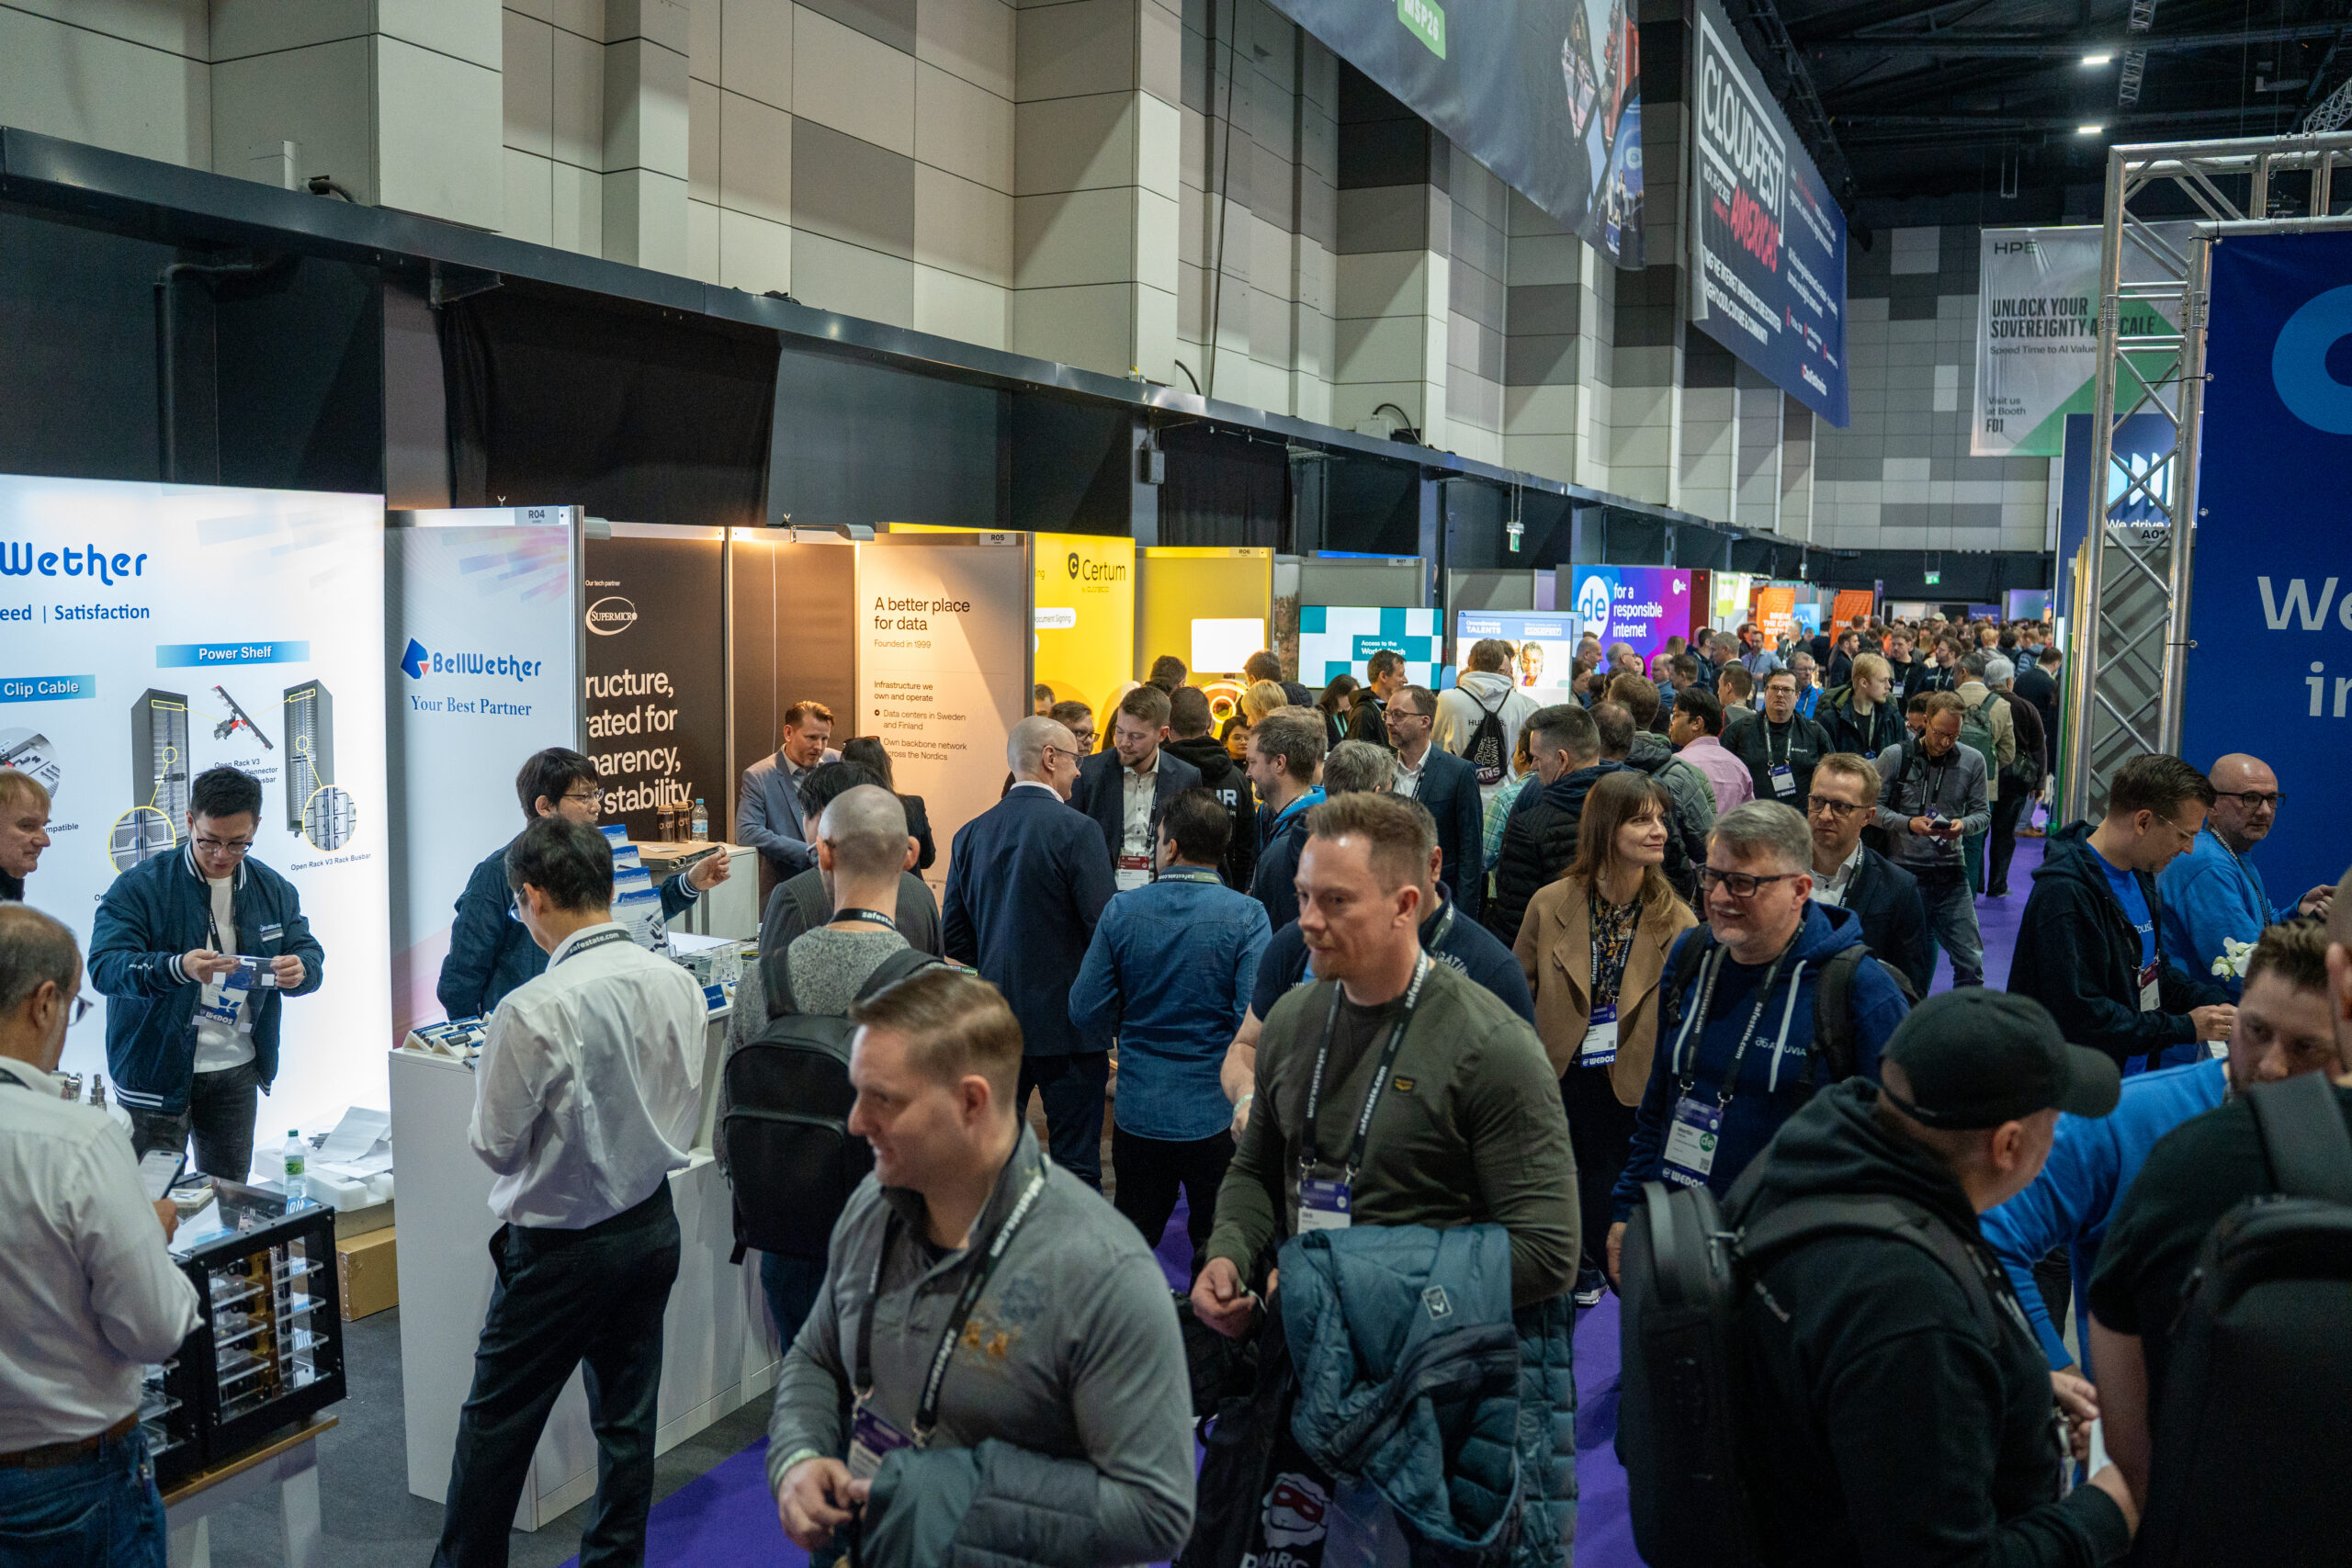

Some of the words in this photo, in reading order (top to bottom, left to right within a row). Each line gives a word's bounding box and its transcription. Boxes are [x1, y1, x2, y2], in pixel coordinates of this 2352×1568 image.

[1702, 54, 1782, 217] CLOUDFEST
[1730, 185, 1779, 273] AMERICAS
[1995, 242, 2039, 255] HPE
[1992, 298, 2047, 318] UNLOCK
[2051, 297, 2088, 316] YOUR
[1991, 318, 2087, 339] SOVEREIGNTY
[2120, 316, 2155, 335] CALE
[1990, 345, 2019, 356] Speed
[2022, 345, 2046, 355] Time
[2047, 345, 2057, 354] to
[2058, 345, 2069, 354] AI
[1988, 396, 2008, 406] Visit
[1999, 406, 2026, 416] Booth
[1986, 419, 2004, 433] F01
[528, 509, 545, 519] R04
[1082, 559, 1126, 581] Certum
[1613, 582, 1627, 600] for
[1628, 589, 1634, 599] a
[54, 604, 150, 621] Satisfaction
[874, 597, 885, 611] A
[888, 597, 930, 612] better
[932, 598, 971, 615] place
[1582, 589, 1606, 622] de
[1613, 602, 1663, 620] responsible
[874, 616, 893, 630] for
[896, 616, 928, 632] data
[1466, 626, 1502, 634] TALENTS
[1613, 622, 1648, 638] internet
[874, 639, 905, 649] Founded
[907, 640, 913, 649] in
[914, 640, 932, 649] 1999
[199, 648, 238, 661] Power
[241, 645, 272, 659] Shelf
[433, 652, 542, 682] BellWether
[4, 682, 34, 698] Clip
[37, 681, 79, 695] Cable
[586, 668, 674, 699] ructure,
[874, 680, 921, 690] Infrastructure
[411, 695, 442, 713] Your
[447, 696, 475, 714] Best
[480, 698, 532, 716] Partner
[906, 694, 933, 703] operate
[645, 704, 678, 732] for
[883, 709, 900, 717] Data
[902, 711, 927, 719] centers
[937, 712, 967, 721] Sweden
[898, 722, 923, 730] Finland
[883, 738, 900, 746] Own
[901, 739, 937, 748] backbone
[938, 742, 967, 750] network
[921, 751, 948, 761] Nordics
[604, 778, 692, 814] stability
[45, 823, 79, 834] mpatible
[350, 853, 371, 862] Busbar
[568, 931, 620, 954] safestate.com
[1694, 976, 1715, 1034] safestate.com
[205, 1011, 234, 1025] WEDOS
[1735, 1001, 1763, 1060] safestate.com
[1768, 1042, 1807, 1056] AUVIA
[1589, 1055, 1615, 1065] WEDOS
[1307, 1047, 1326, 1119] safestate.com
[1358, 1065, 1388, 1136] safestate.com
